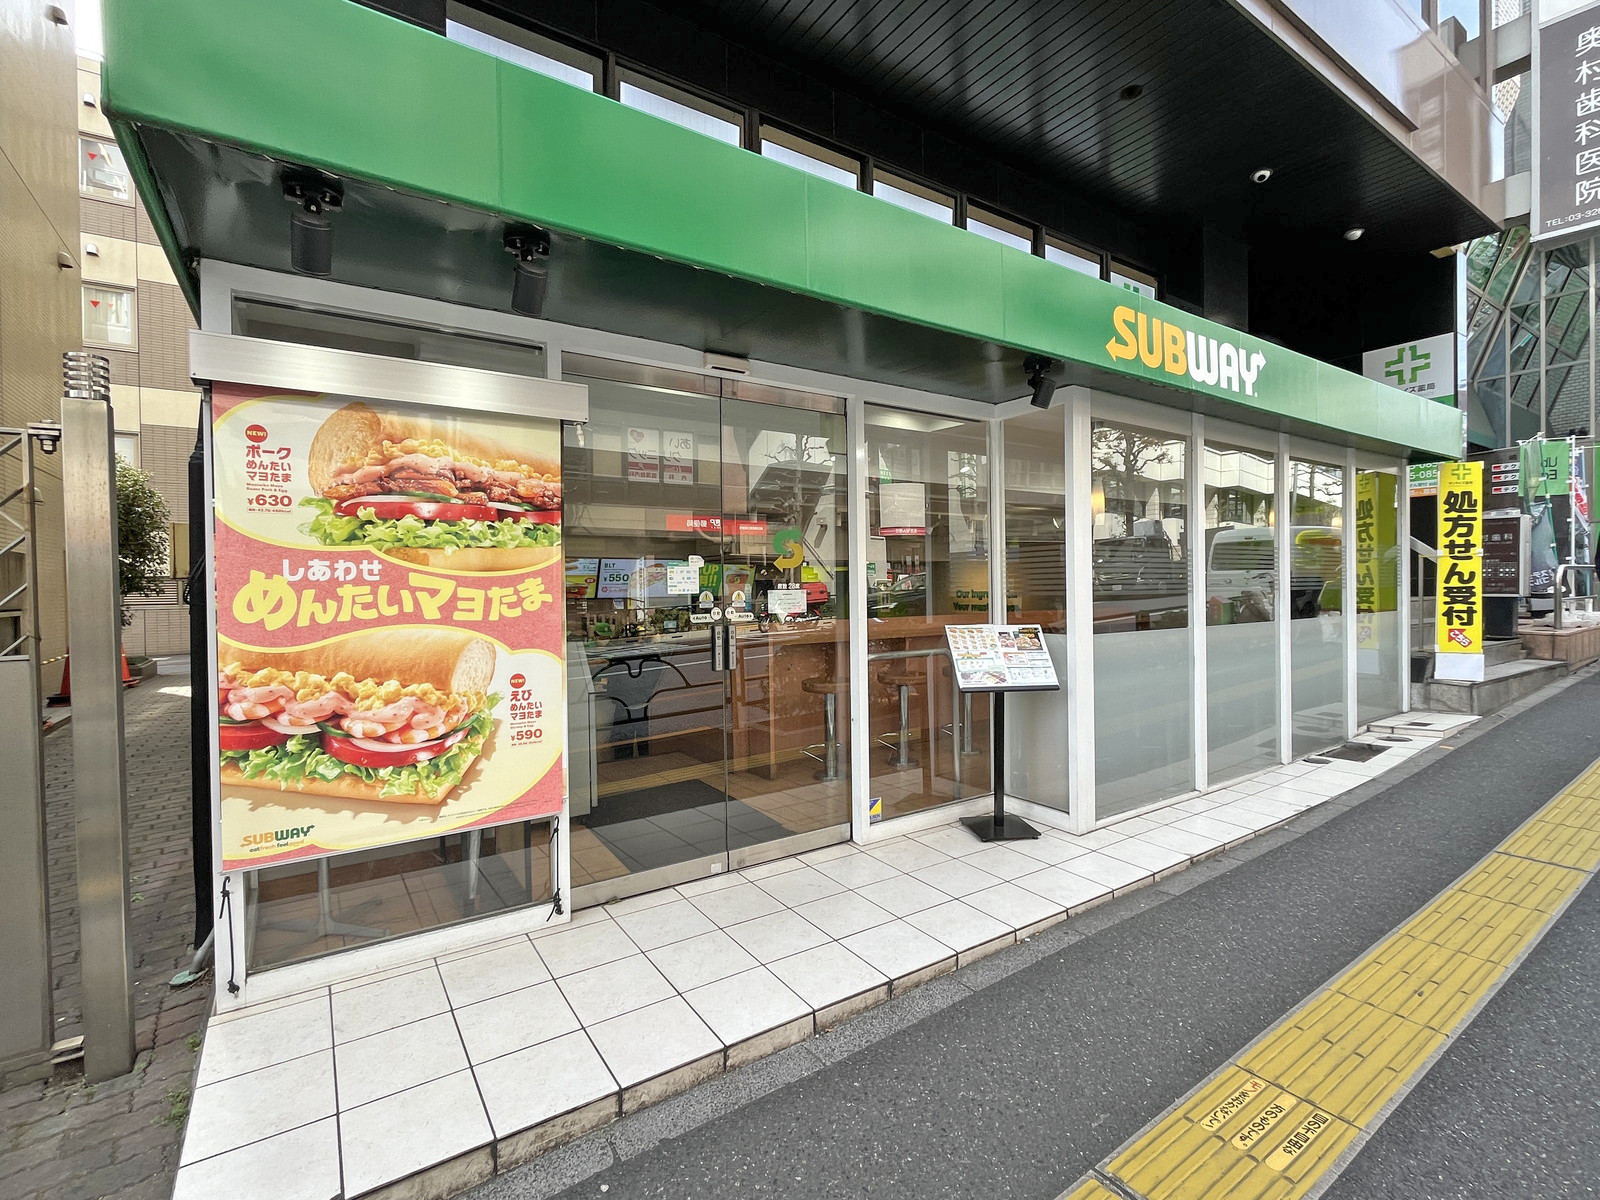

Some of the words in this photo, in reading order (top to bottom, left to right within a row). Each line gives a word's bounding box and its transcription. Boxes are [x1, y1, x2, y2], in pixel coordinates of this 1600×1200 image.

[1105, 305, 1267, 397] SUBWAY
[246, 444, 291, 460] ポーク
[246, 459, 291, 472] めんたい
[246, 470, 292, 483] マヨたま
[1443, 490, 1478, 626] 処方せん受付
[282, 559, 383, 582] しあわせ
[232, 569, 554, 631] めんたいマヨたま
[1450, 630, 1471, 647] こちら
[510, 689, 532, 702] えび
[510, 701, 543, 712] めんたい
[510, 710, 543, 721] マヨたま
[240, 824, 315, 848] SUBWAY
[1282, 1112, 1330, 1156] 目の不自由な
